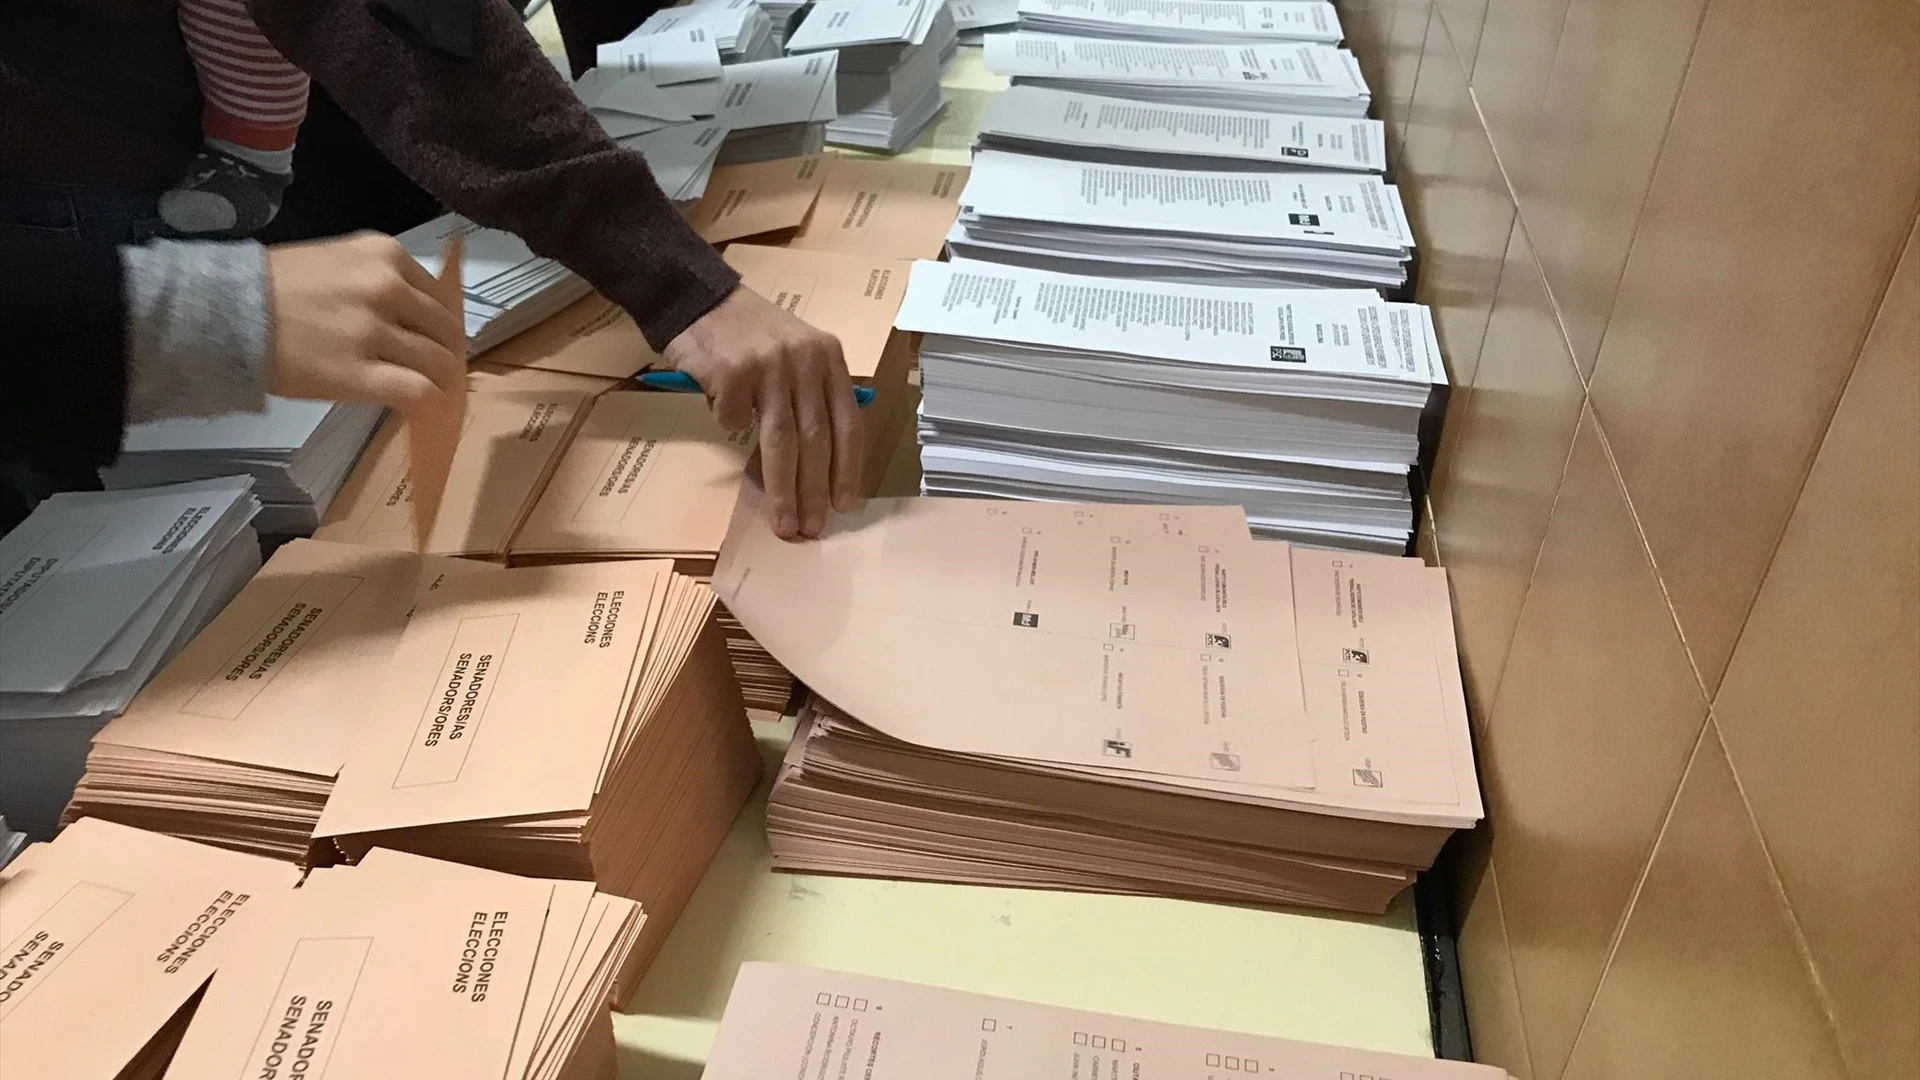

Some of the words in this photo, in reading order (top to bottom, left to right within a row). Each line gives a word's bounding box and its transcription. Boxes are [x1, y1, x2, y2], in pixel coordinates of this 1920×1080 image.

[518, 402, 546, 441] ELECCIONS
[529, 402, 558, 443] ELECCIONES
[598, 435, 642, 498] SENADORS/ORES
[617, 438, 657, 495] SENADORES/AS
[151, 506, 196, 551] ELECCIONS
[161, 506, 211, 555] ELECCIONES
[225, 602, 308, 683] SENADORS/ORES
[248, 606, 324, 681] SENADORES/AS
[583, 591, 609, 645] ELECCIONS
[598, 590, 625, 649] ELECCIONES
[424, 652, 473, 748] SENADORS/ORES
[448, 653, 493, 741] SENADORES/AS
[156, 889, 233, 963] ELECCIONS
[164, 893, 250, 975] ELECCIONES
[452, 911, 488, 994] ELECCIONS
[470, 911, 509, 1003] ELECCIONES
[258, 994, 307, 1080] SENADOR
